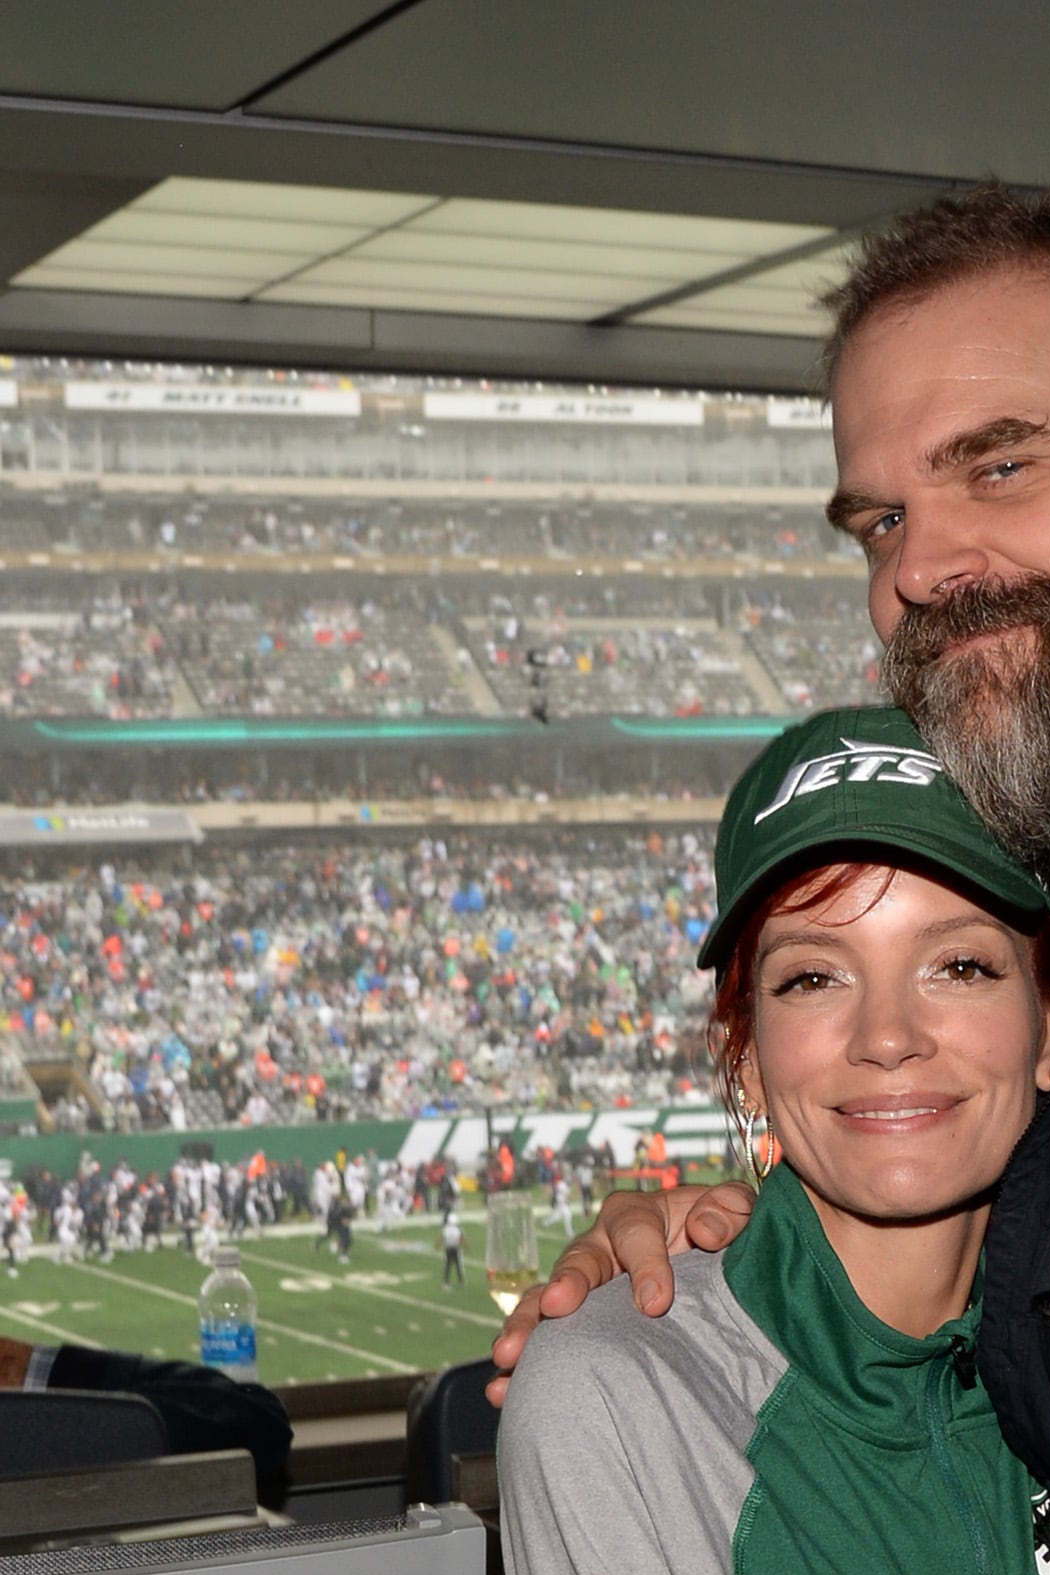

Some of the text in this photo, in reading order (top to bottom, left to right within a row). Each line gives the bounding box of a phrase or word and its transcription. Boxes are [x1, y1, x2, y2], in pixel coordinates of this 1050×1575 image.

[162, 391, 225, 404] MATT
[754, 737, 943, 825] JETS
[68, 816, 150, 830] MetLife
